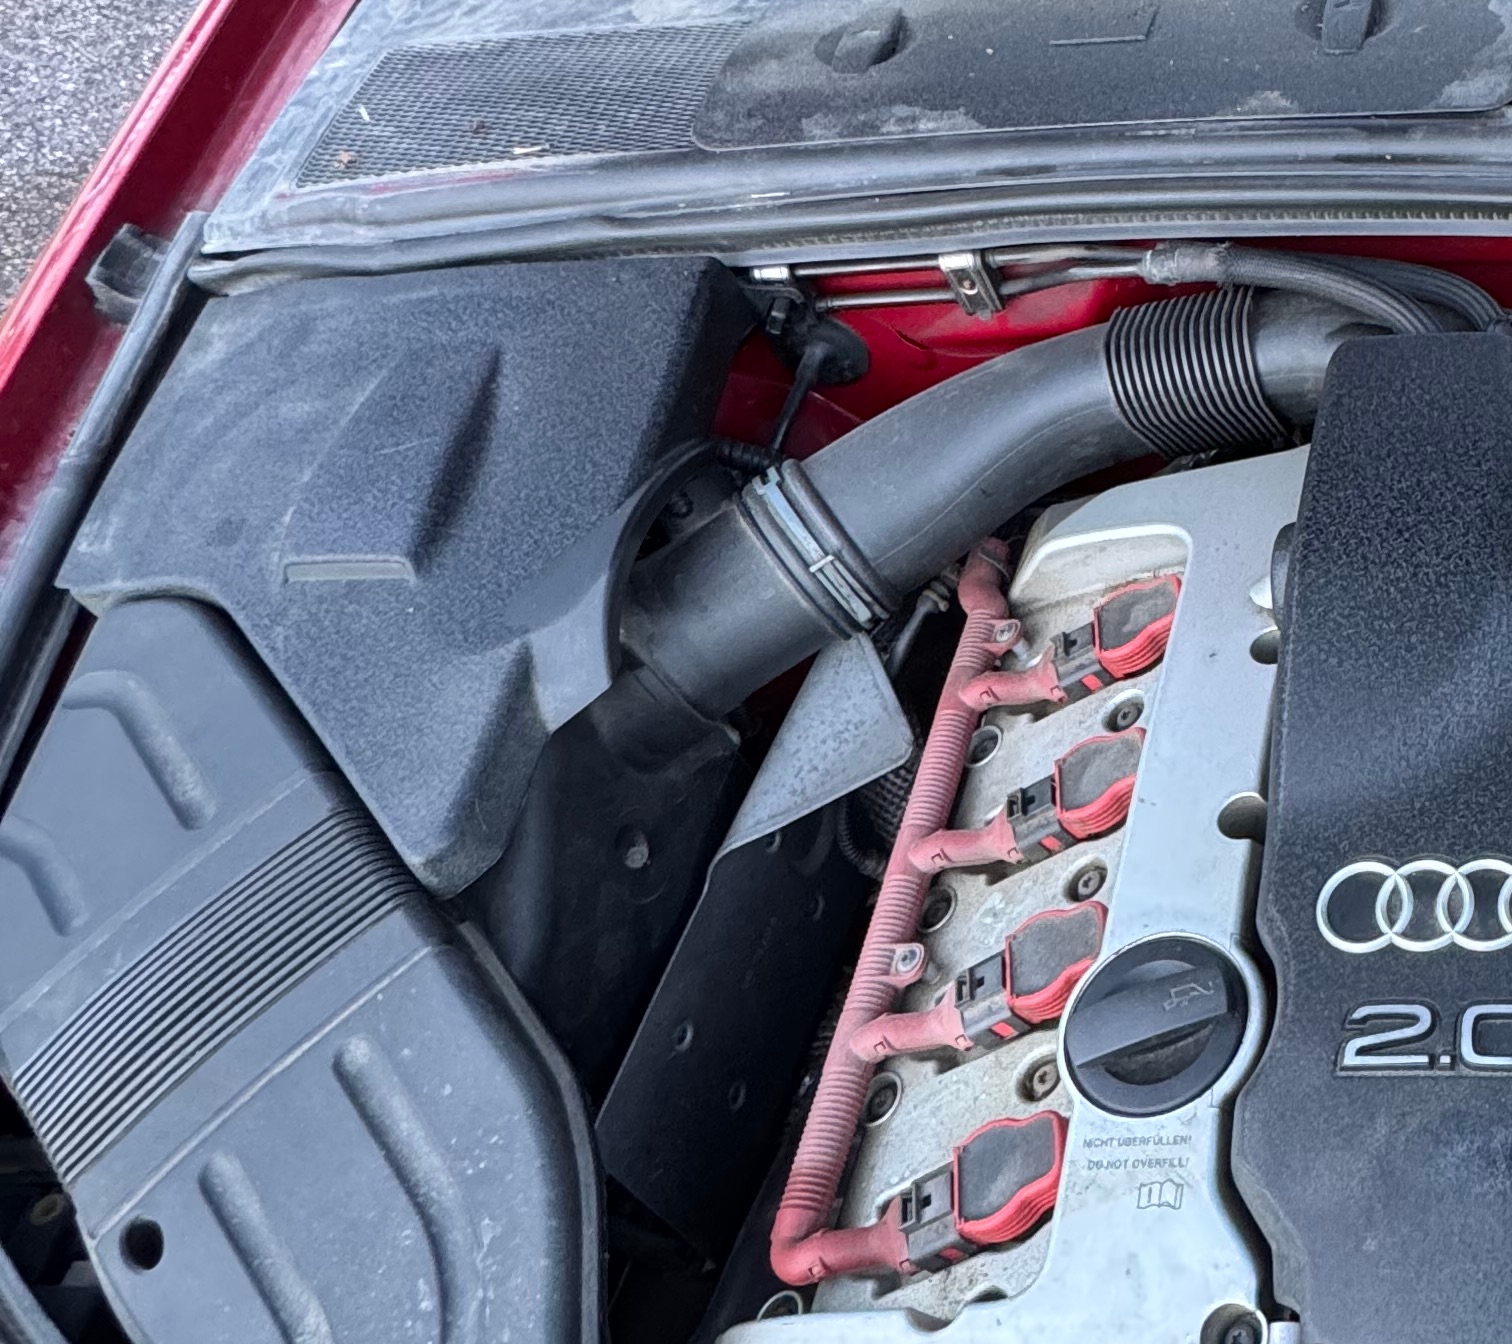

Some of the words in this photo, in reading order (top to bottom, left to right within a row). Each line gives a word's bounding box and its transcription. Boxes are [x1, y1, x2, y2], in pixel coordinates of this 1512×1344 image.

[1082, 1137, 1117, 1149] NICHT
[1086, 1159, 1104, 1171] DO
[1103, 1157, 1130, 1171] NOT
[1131, 1156, 1190, 1170] OVERFILL!
